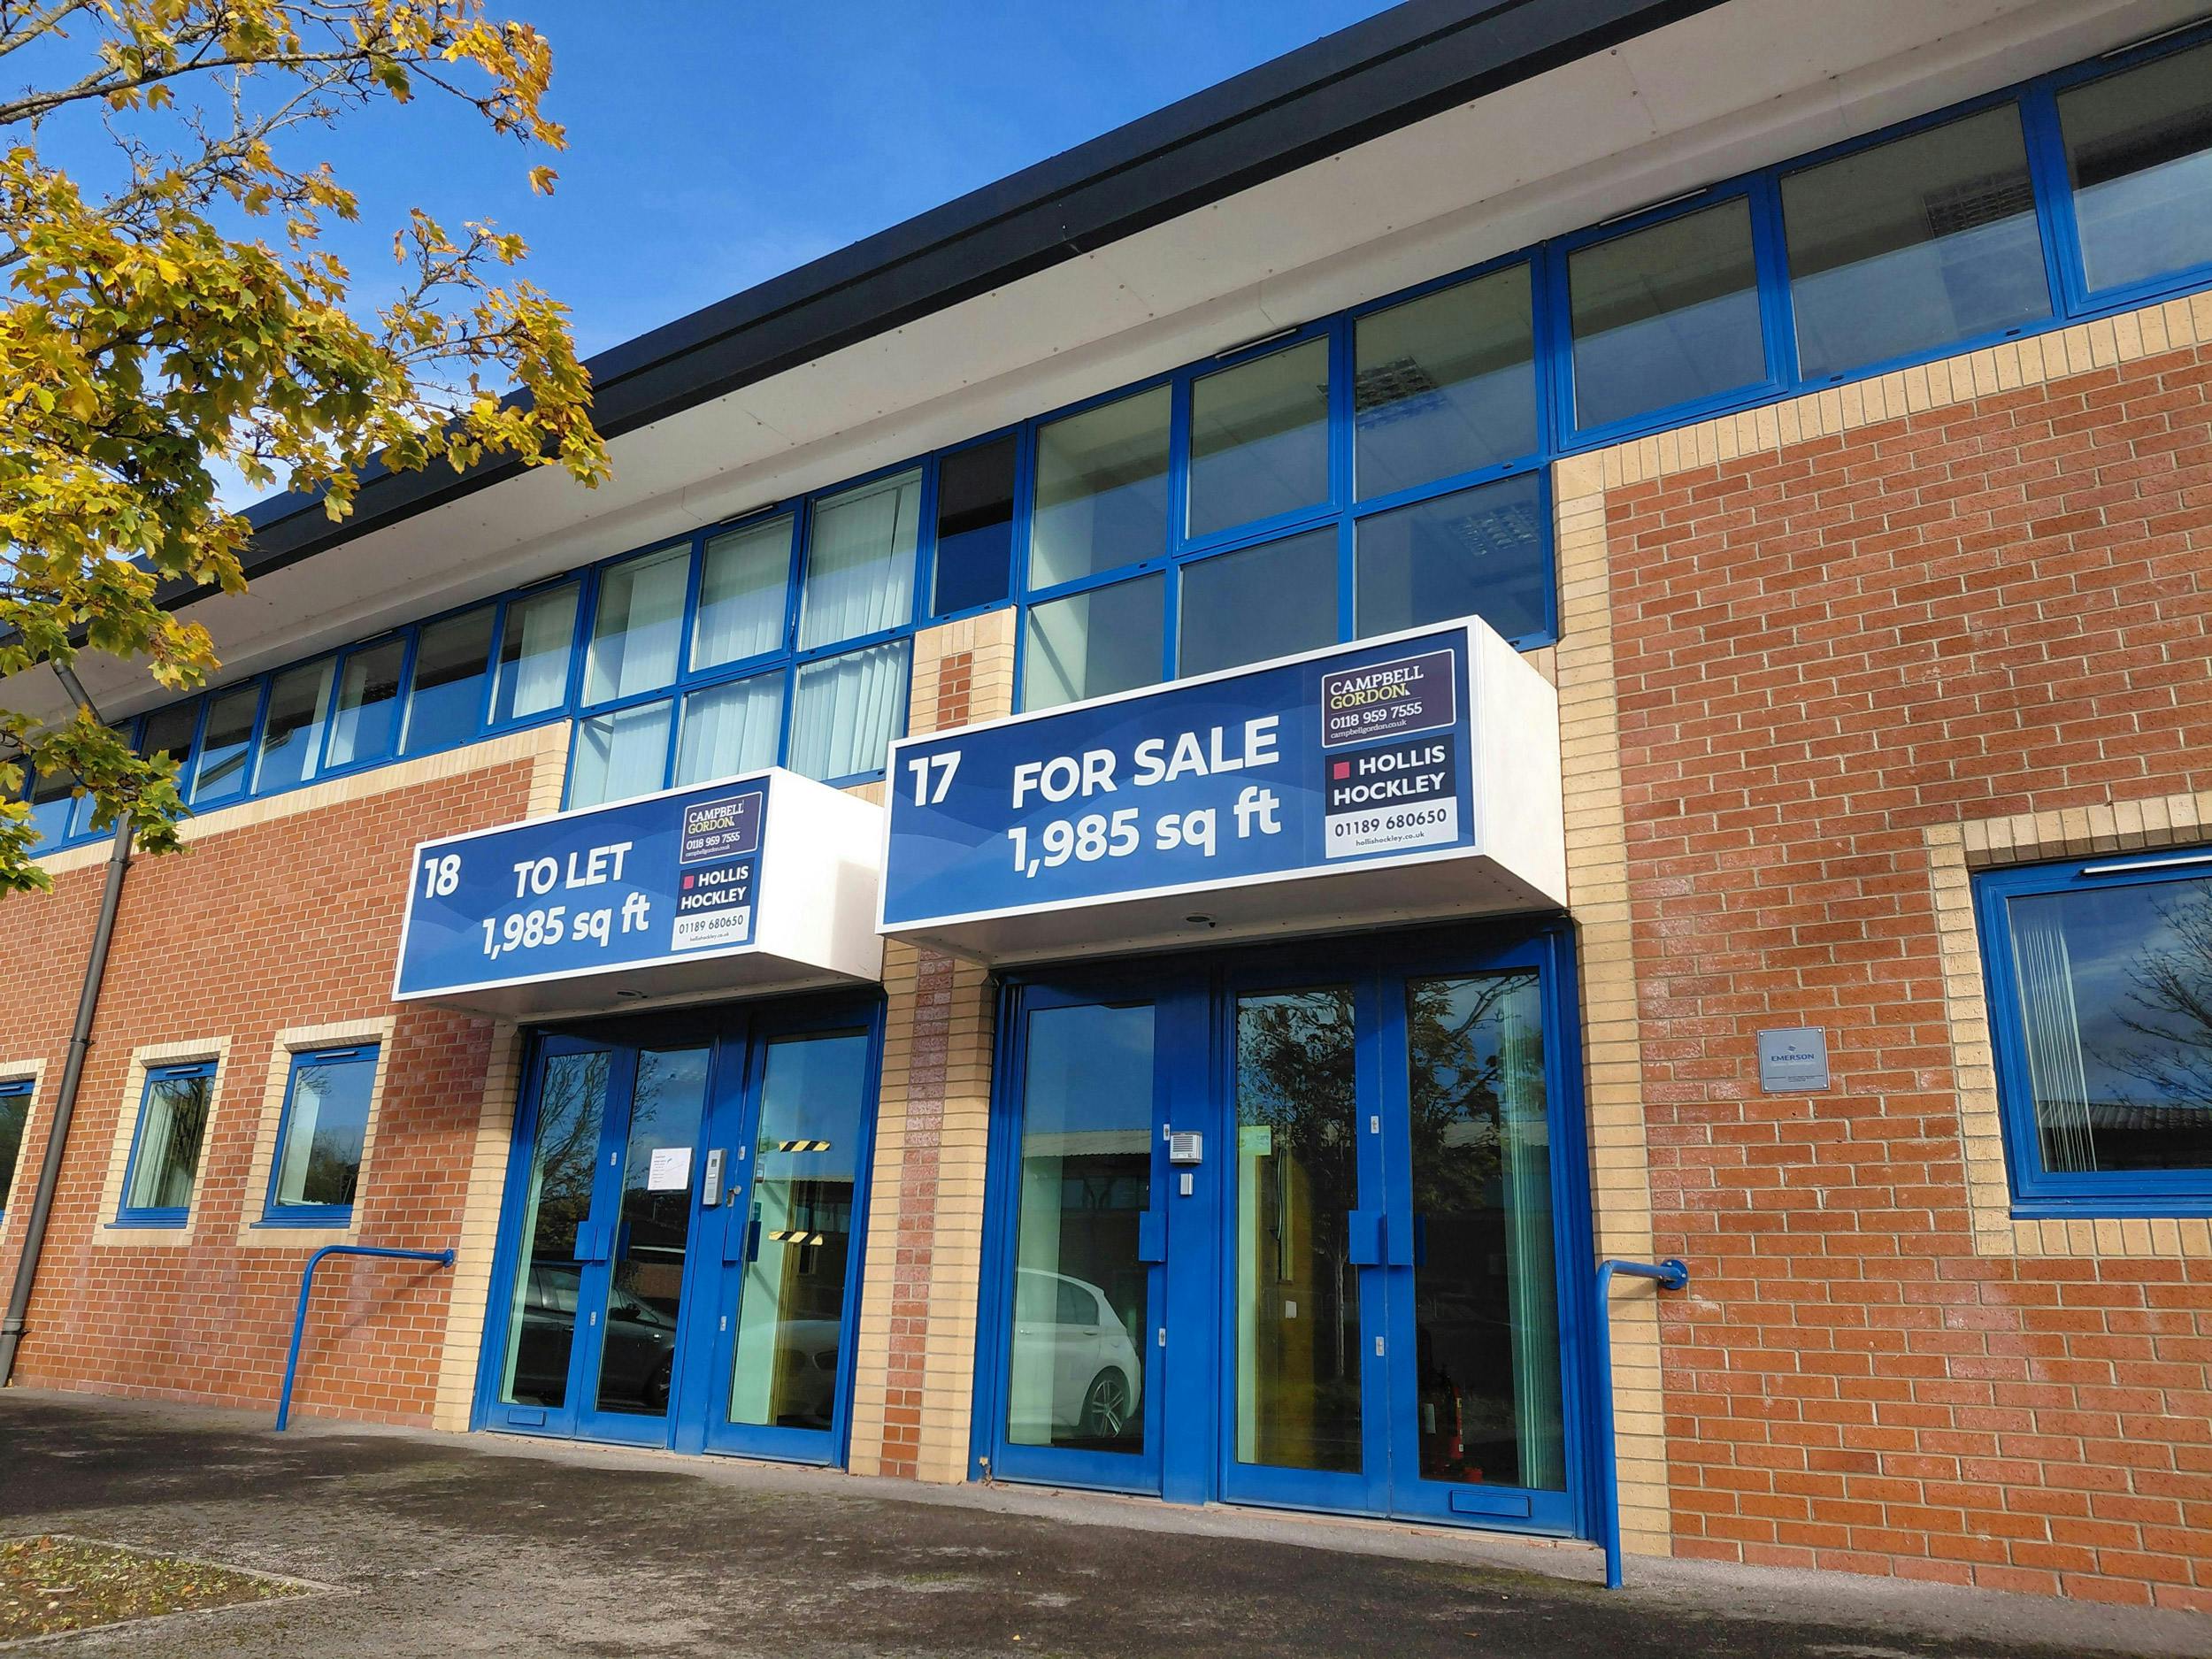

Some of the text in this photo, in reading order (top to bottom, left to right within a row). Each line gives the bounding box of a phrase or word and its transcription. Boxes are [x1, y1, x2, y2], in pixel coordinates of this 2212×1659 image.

[1330, 665, 1424, 695] CAMPBELL
[1330, 682, 1407, 710] GORDON
[1330, 702, 1423, 730] 0118 959 7555
[1330, 719, 1407, 739] campbellgordon.co.uk
[1012, 715, 1279, 809] FOR SALE
[1359, 745, 1446, 776] HOLLIS
[909, 750, 962, 807] 17
[1333, 772, 1445, 806] HOCKLEY
[689, 803, 744, 823] CAMPBELL
[1334, 809, 1447, 837] 01189 680650
[686, 831, 741, 850] 0118 959 7555
[1008, 786, 1281, 879] 1,985 sq ft
[1356, 831, 1425, 847] hollishockley.co.uk
[423, 855, 461, 898] 18
[513, 841, 633, 898] TO LET
[698, 866, 749, 887] HOLLIS
[680, 886, 747, 910] HOCKLEY
[482, 891, 650, 960] 1,985 sq ft
[679, 914, 744, 934] 01189 680650
